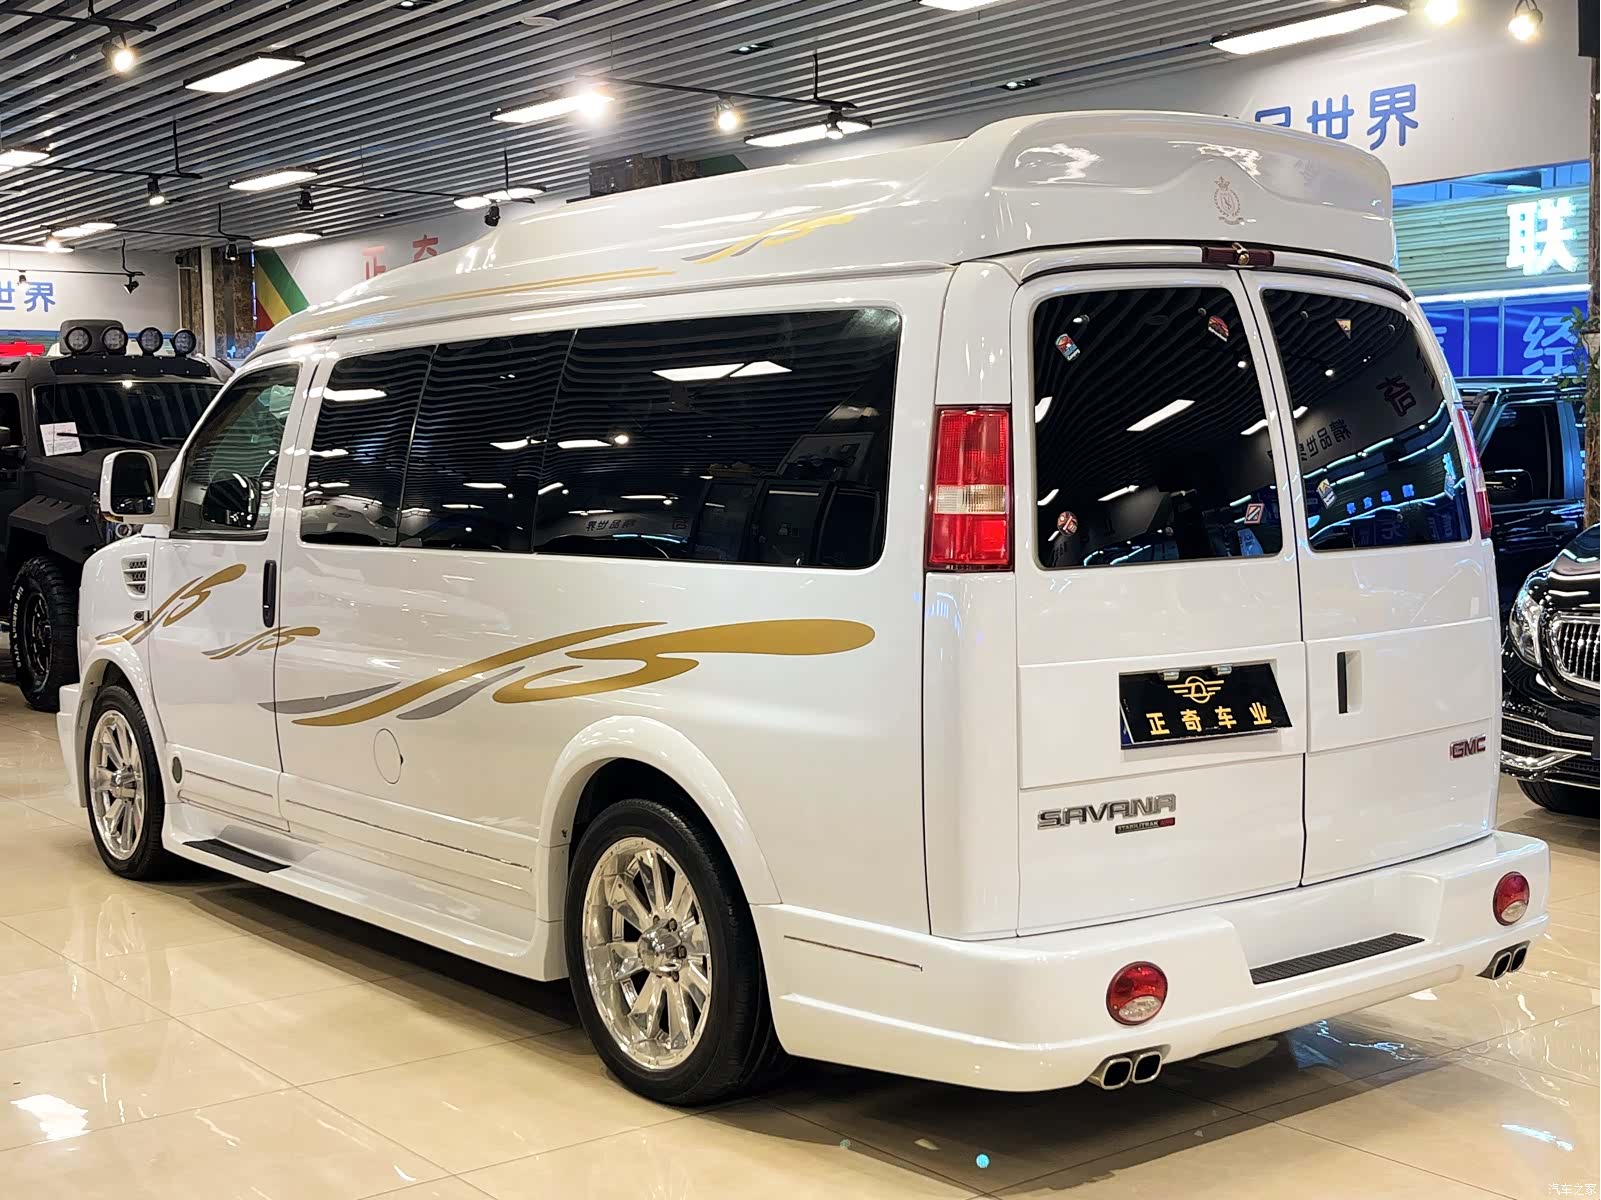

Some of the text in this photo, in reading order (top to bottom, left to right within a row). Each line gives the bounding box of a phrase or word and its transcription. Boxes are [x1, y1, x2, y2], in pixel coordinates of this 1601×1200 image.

[1506, 196, 1580, 275] 联
[1146, 702, 1272, 735] 正奇车业
[1450, 735, 1487, 760] GMC
[1037, 794, 1177, 831] SAVANA
